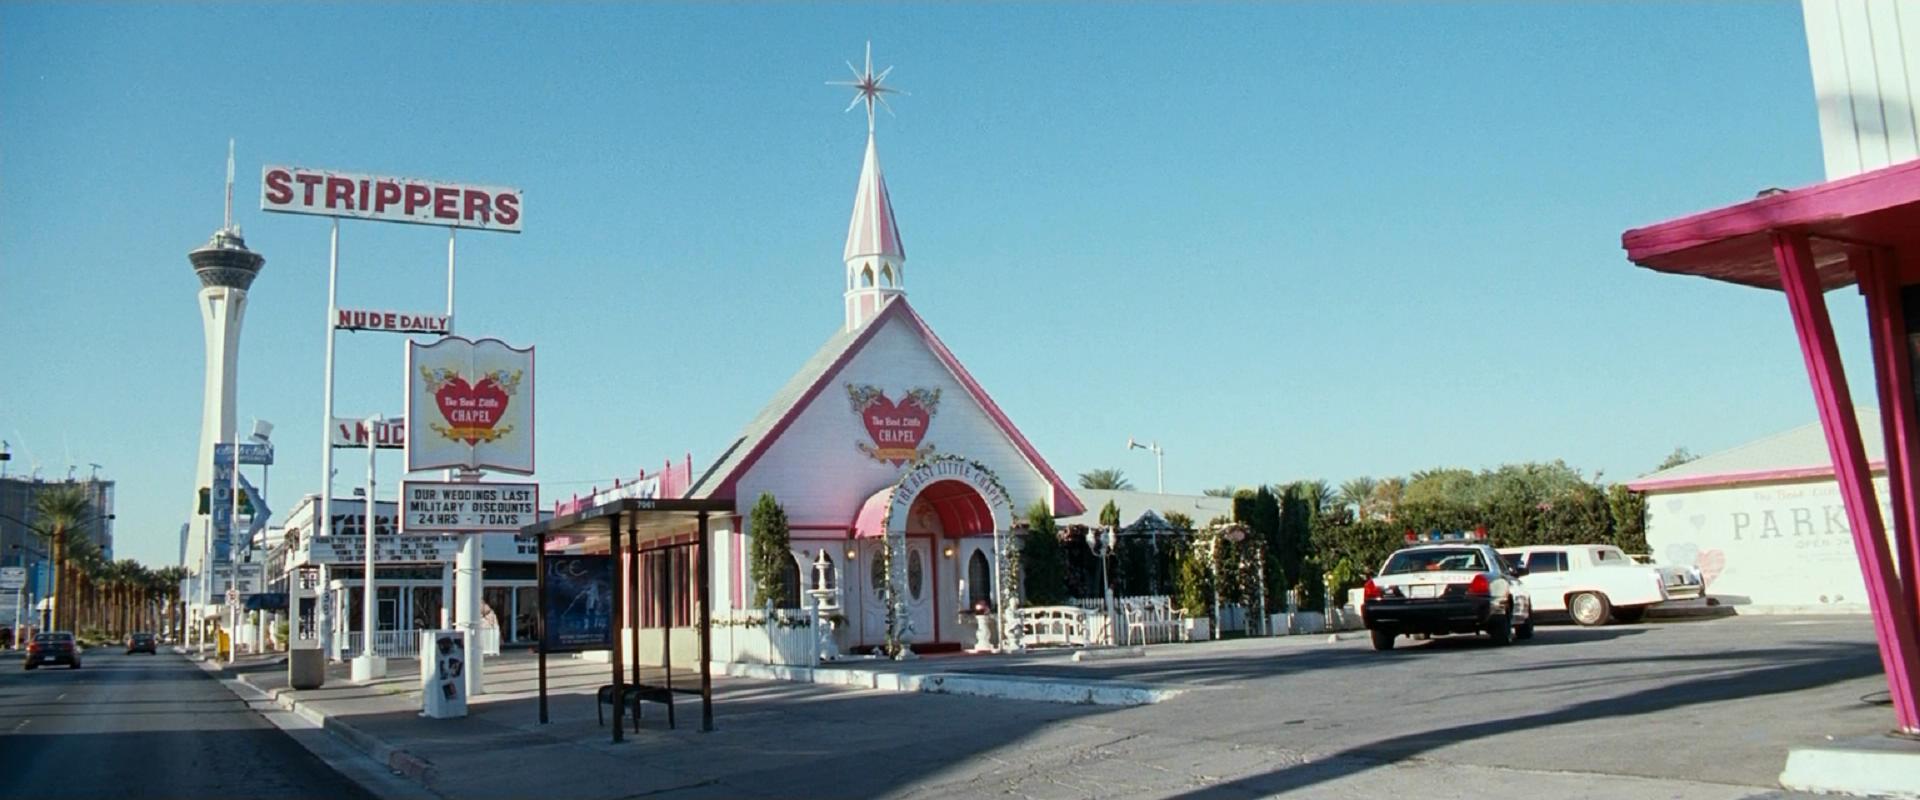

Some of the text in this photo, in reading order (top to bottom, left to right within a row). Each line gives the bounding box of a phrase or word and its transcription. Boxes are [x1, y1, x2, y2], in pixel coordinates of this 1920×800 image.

[265, 169, 519, 226] STRIPPERS
[338, 310, 447, 330] NUDE DAILY
[451, 409, 492, 424] CHAPEL
[355, 421, 405, 443] NUD
[878, 428, 915, 442] CHAPEL
[897, 462, 1003, 508] THE BEST LITTLE CHAPEL
[414, 489, 530, 501] OUR WEDDINGS LAST
[410, 501, 532, 513] MILITARY DISCOUNTS
[418, 513, 434, 524] 24
[437, 514, 458, 524] HRS
[479, 514, 486, 525] 7
[489, 514, 519, 525] DAYS
[1730, 504, 1853, 541] PARK
